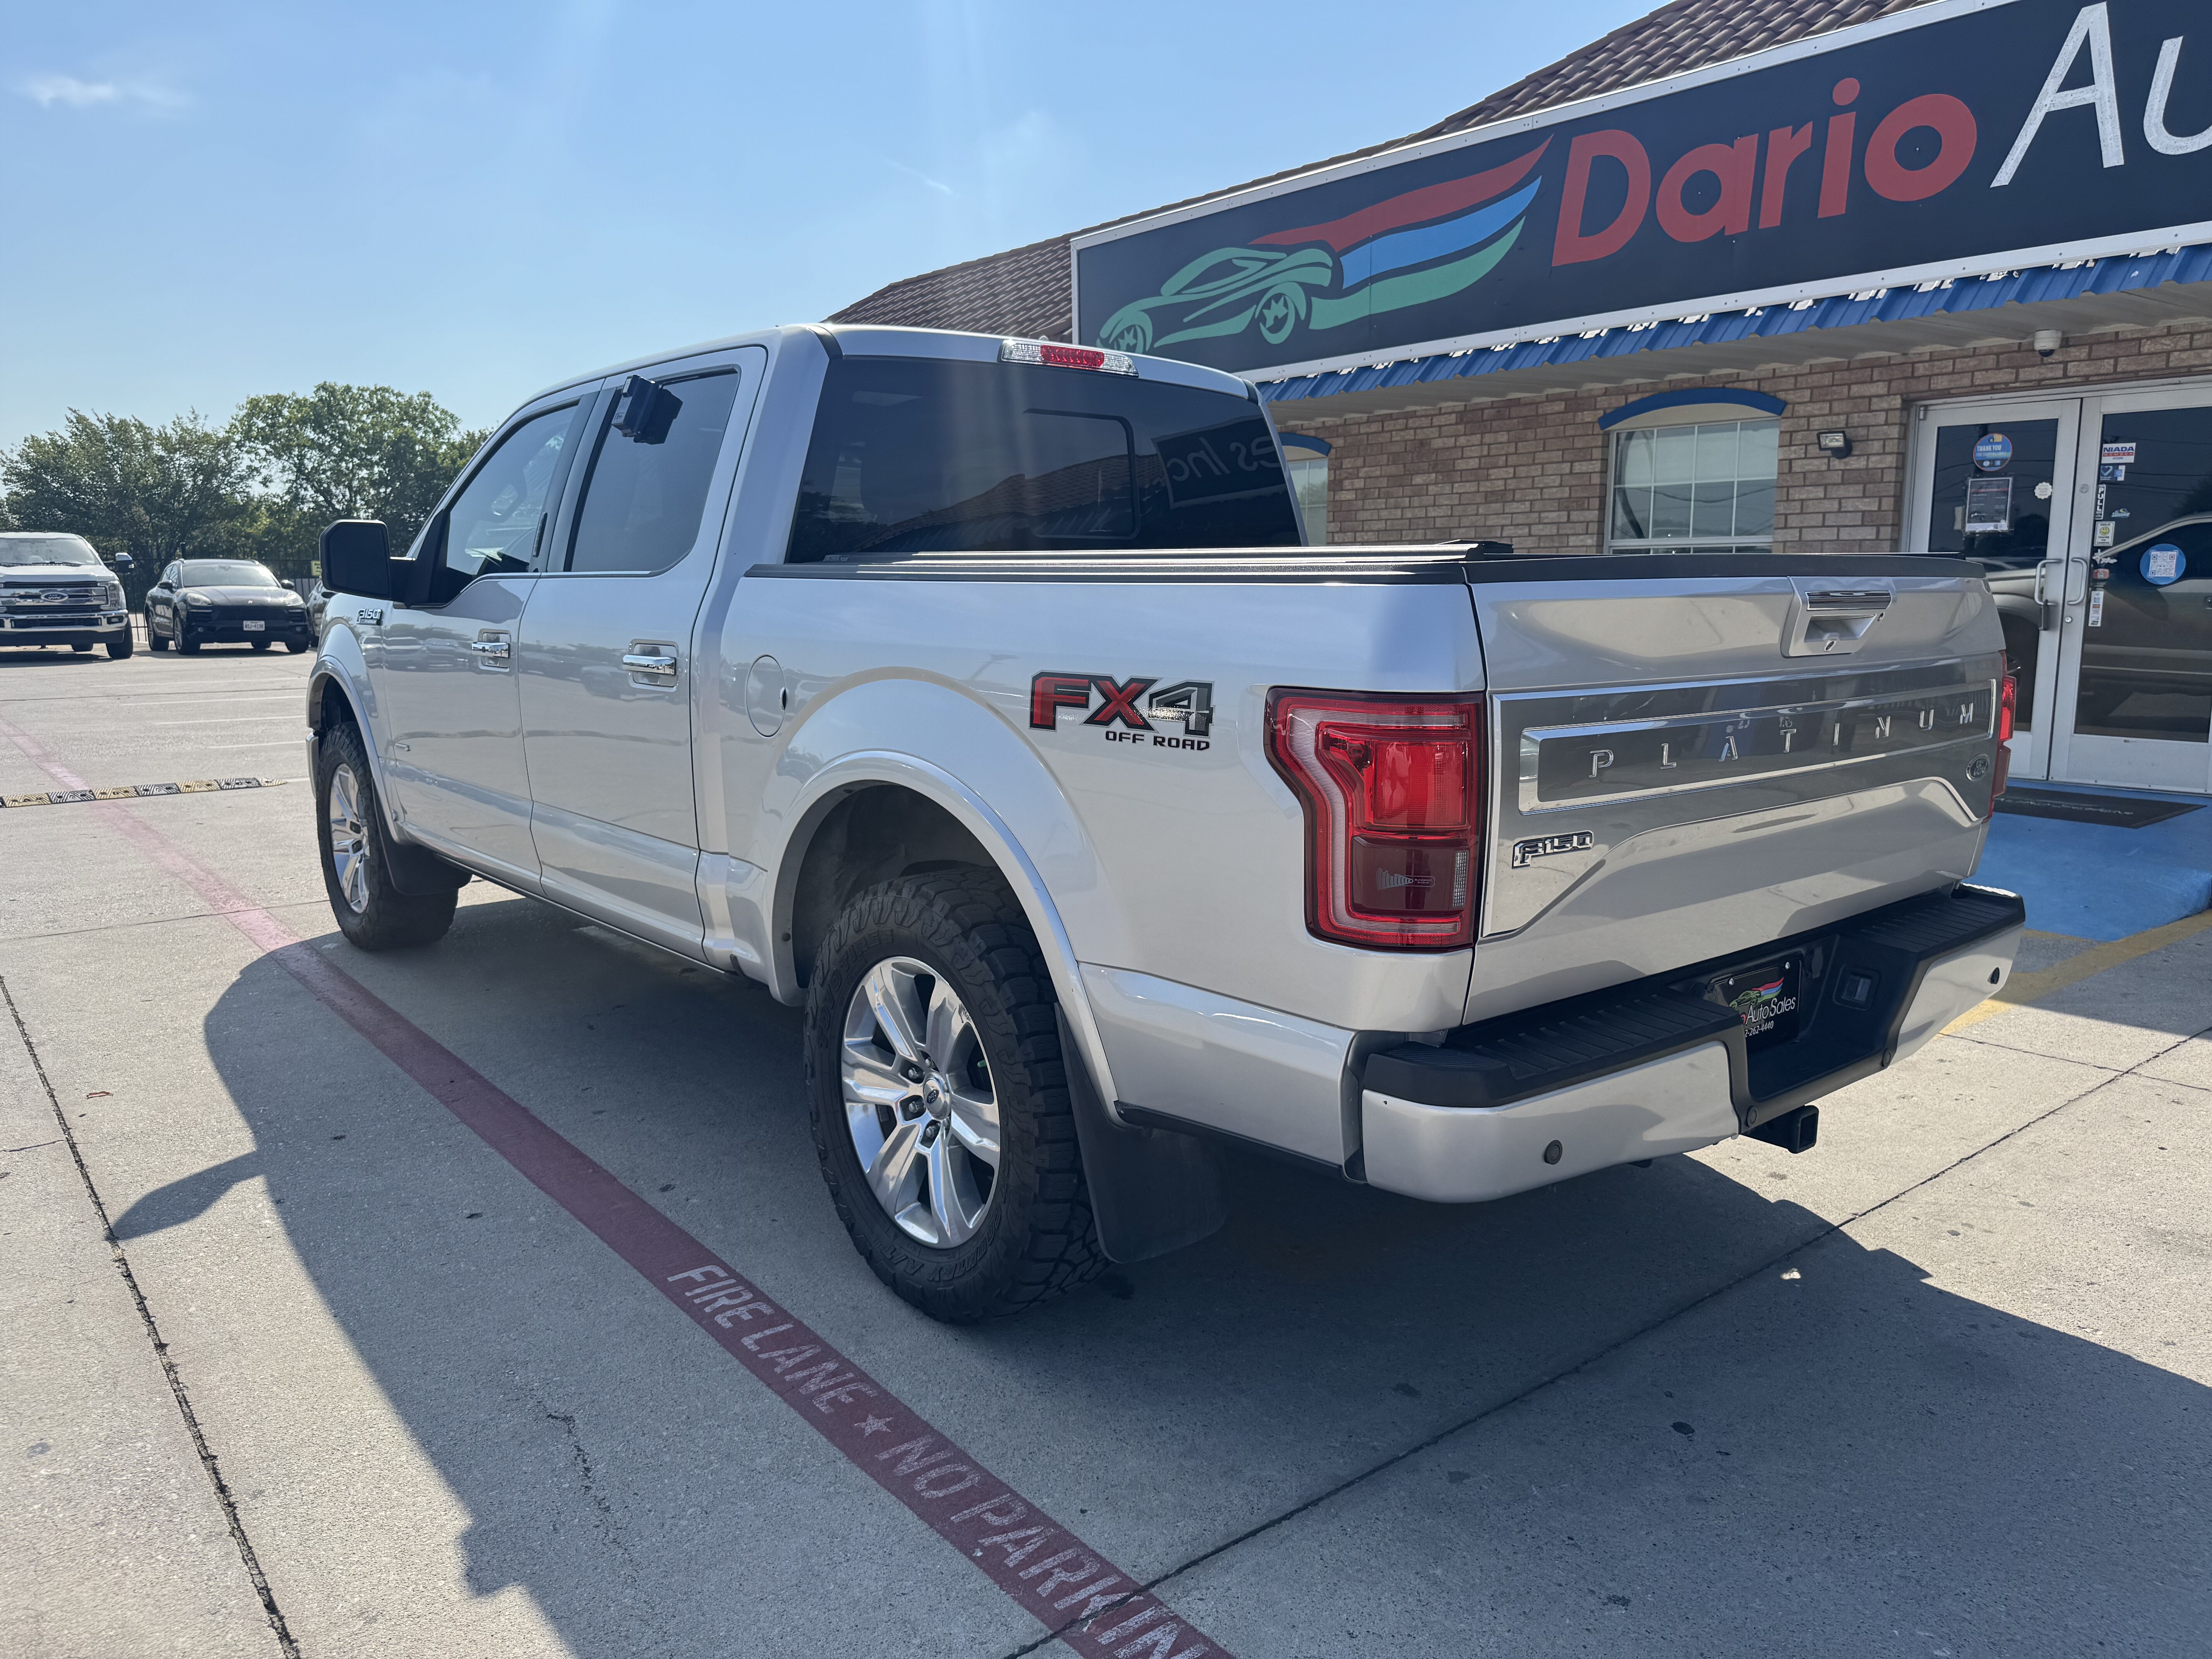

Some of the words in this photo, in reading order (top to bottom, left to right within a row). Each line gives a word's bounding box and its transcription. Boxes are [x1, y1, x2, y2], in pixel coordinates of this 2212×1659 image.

[1552, 77, 1977, 268] Dario
[356, 609, 381, 624] F150
[1029, 670, 1215, 738] FX4
[1105, 730, 1145, 744] OFF
[1153, 735, 1210, 751] ROAD
[1588, 702, 1974, 778] PLATINUM
[1512, 831, 1593, 869] F150
[840, 929, 893, 971] TIRES
[1745, 1004, 1769, 1025] Auto
[1770, 996, 1796, 1017] Sales
[667, 1264, 775, 1330] FIRE
[740, 1322, 877, 1414] LANE
[877, 1434, 981, 1499] NO
